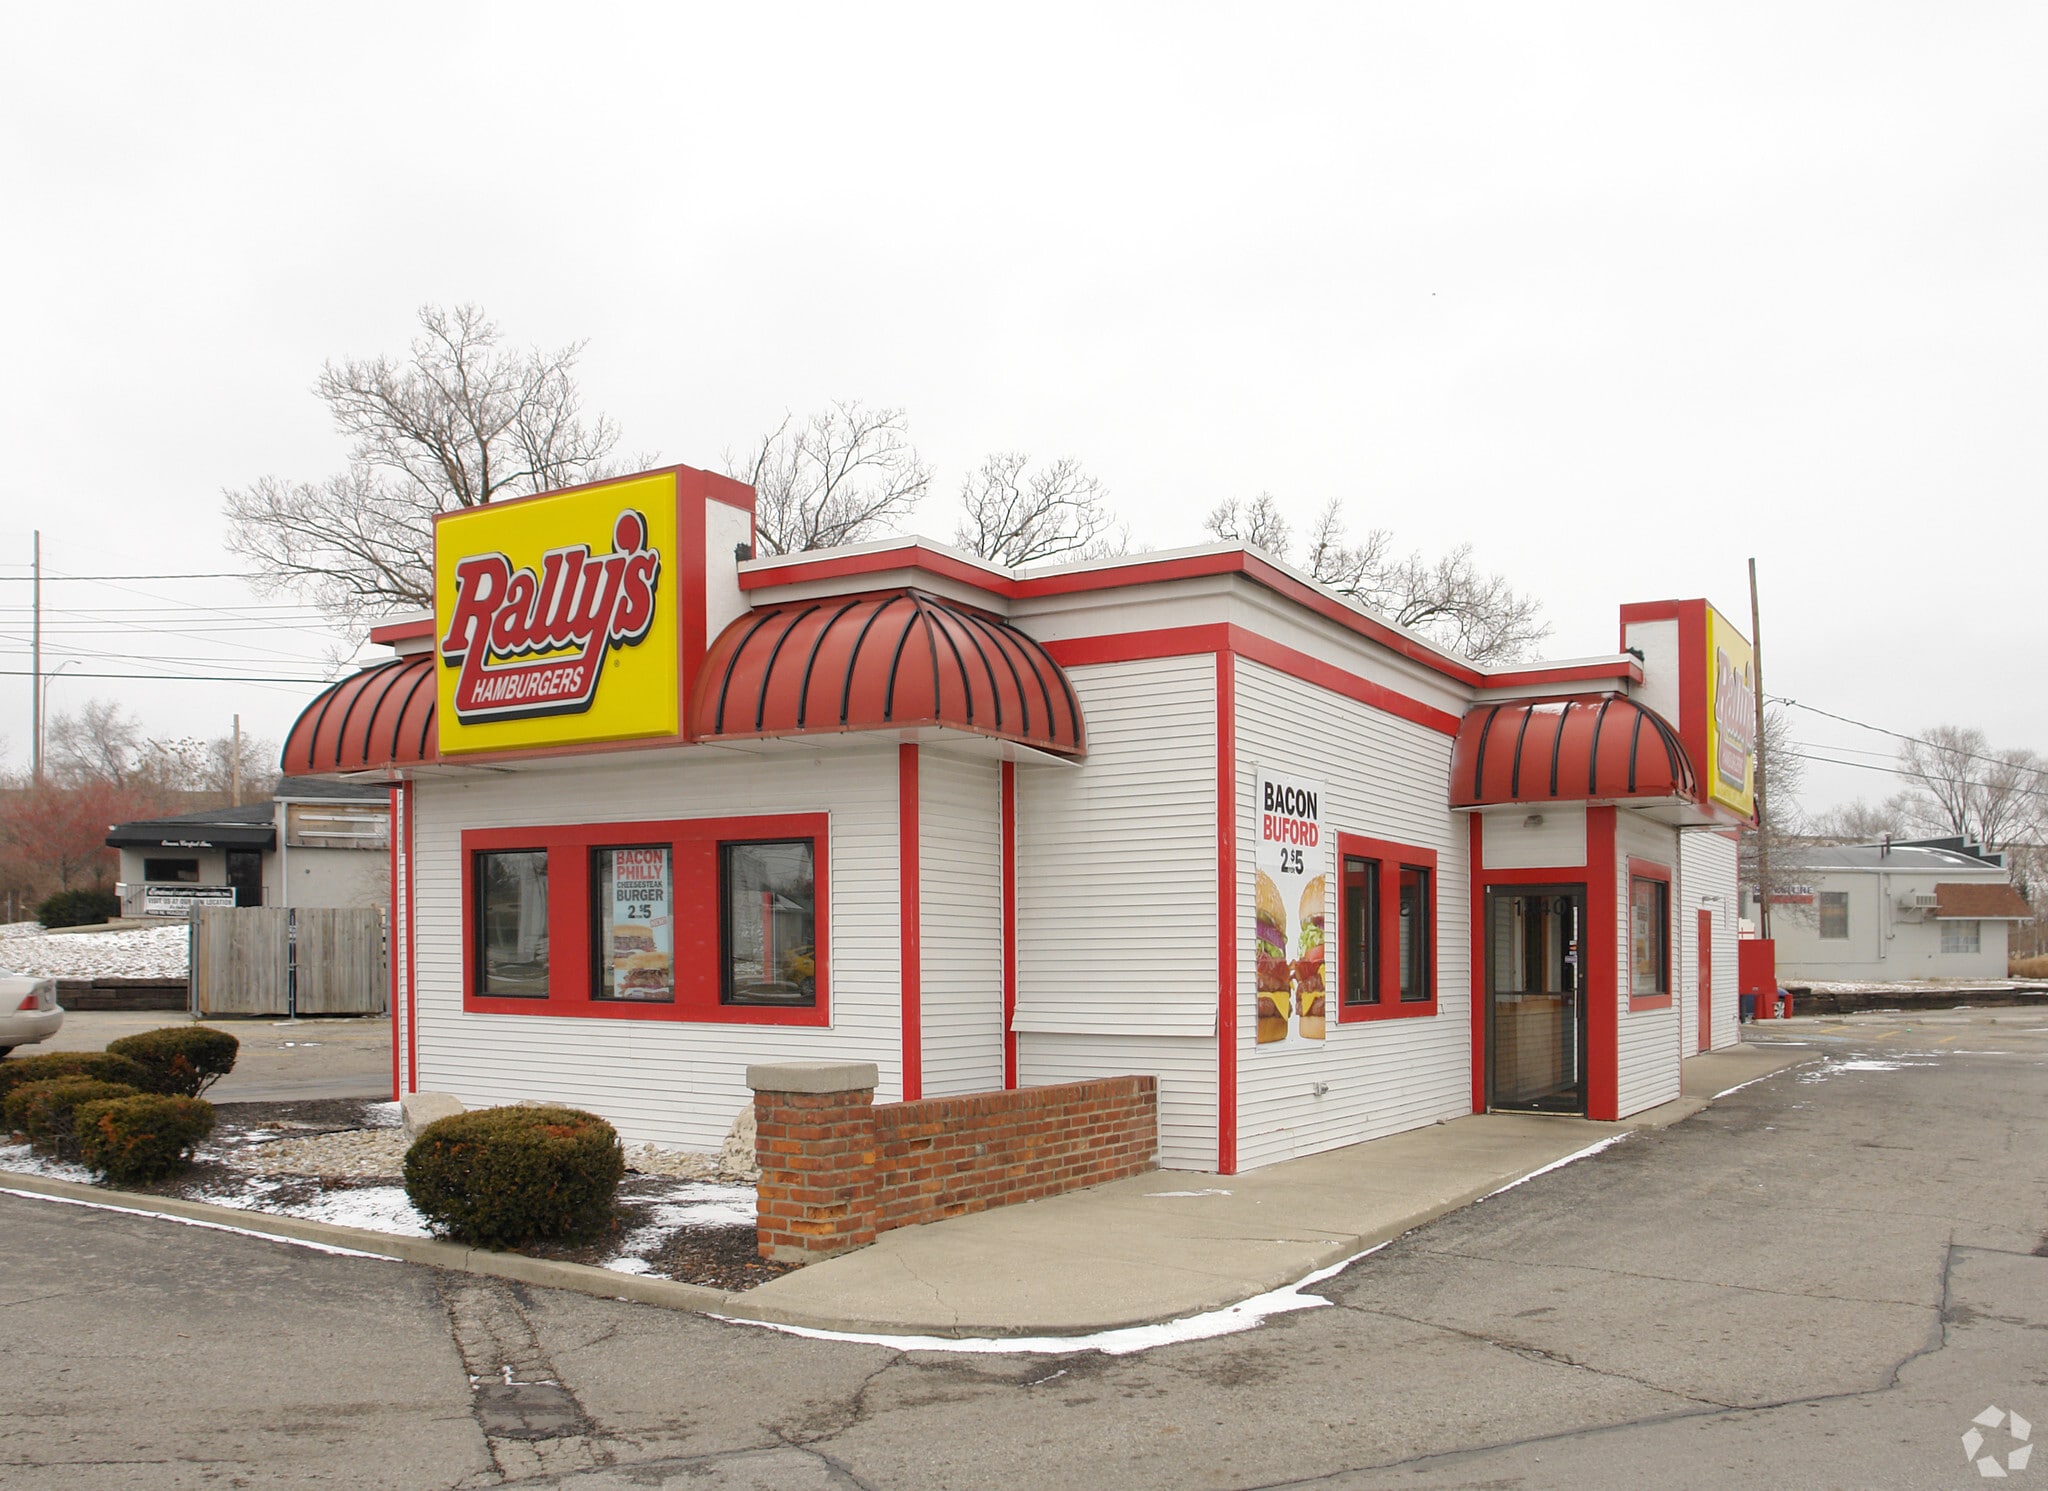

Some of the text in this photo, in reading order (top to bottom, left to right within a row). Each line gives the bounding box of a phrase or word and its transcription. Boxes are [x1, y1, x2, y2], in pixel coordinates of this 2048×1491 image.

[441, 508, 661, 674] Rally's
[471, 666, 584, 703] HAMBURGERS
[1264, 781, 1317, 820] BACON
[1263, 814, 1319, 847] BUFORD
[616, 850, 663, 865] BACON
[616, 865, 663, 880] PHILLY
[616, 889, 664, 901] BURGER
